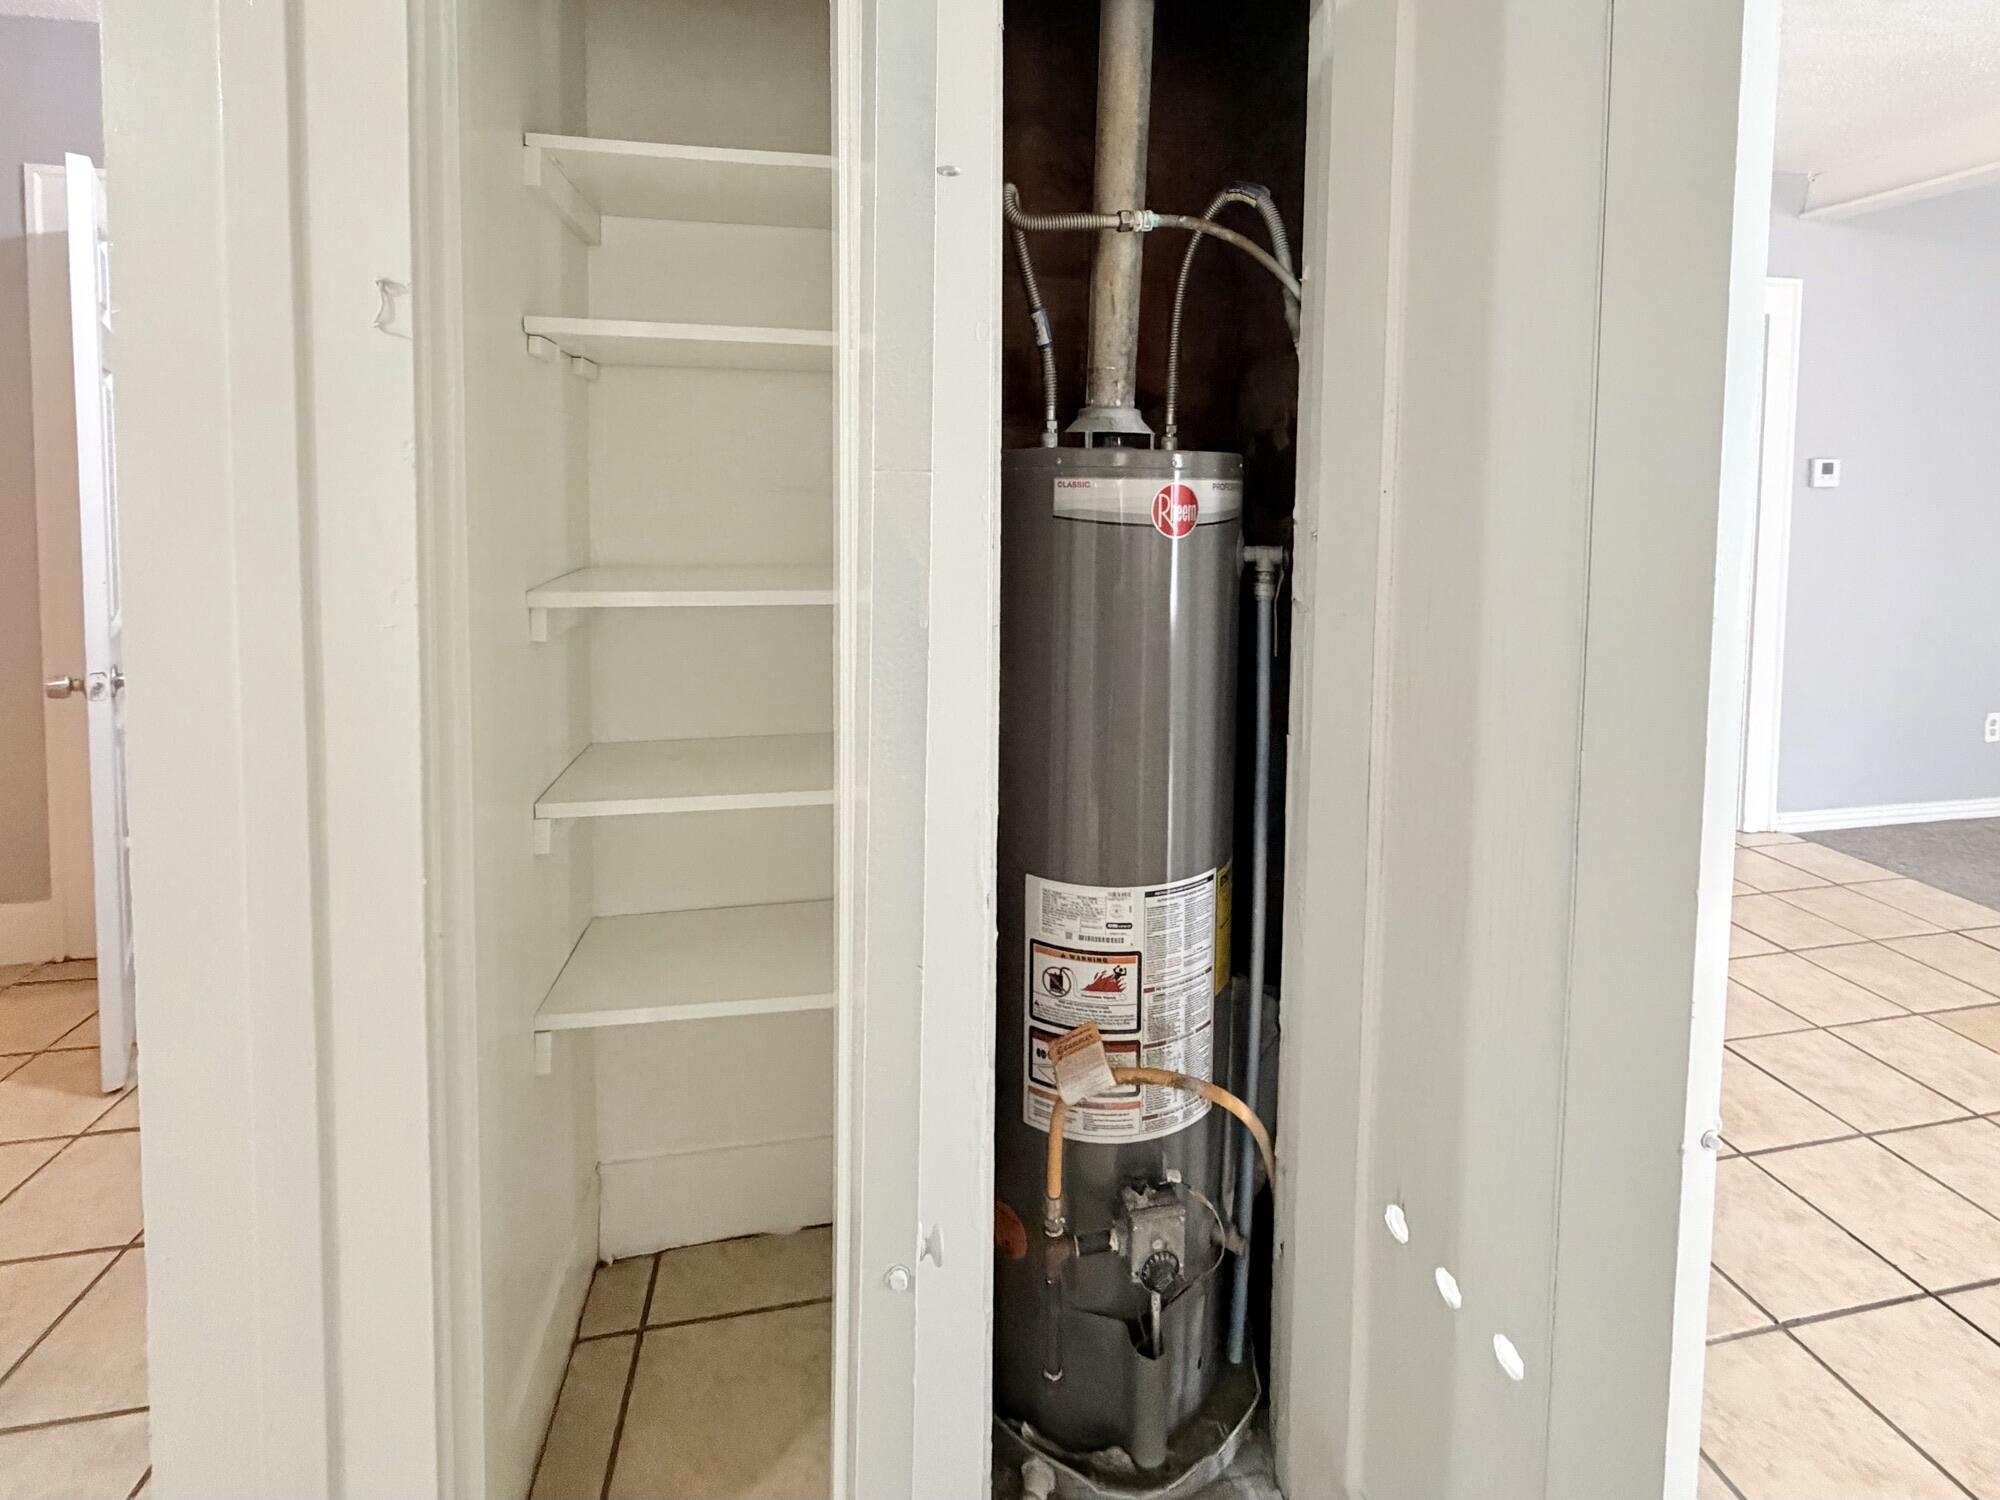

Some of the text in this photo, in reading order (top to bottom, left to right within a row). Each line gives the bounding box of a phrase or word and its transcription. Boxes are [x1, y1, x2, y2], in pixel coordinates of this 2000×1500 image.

[1057, 481, 1091, 489] CLASSIC
[1158, 484, 1197, 528] Rheem
[1069, 954, 1108, 964] WARNING
